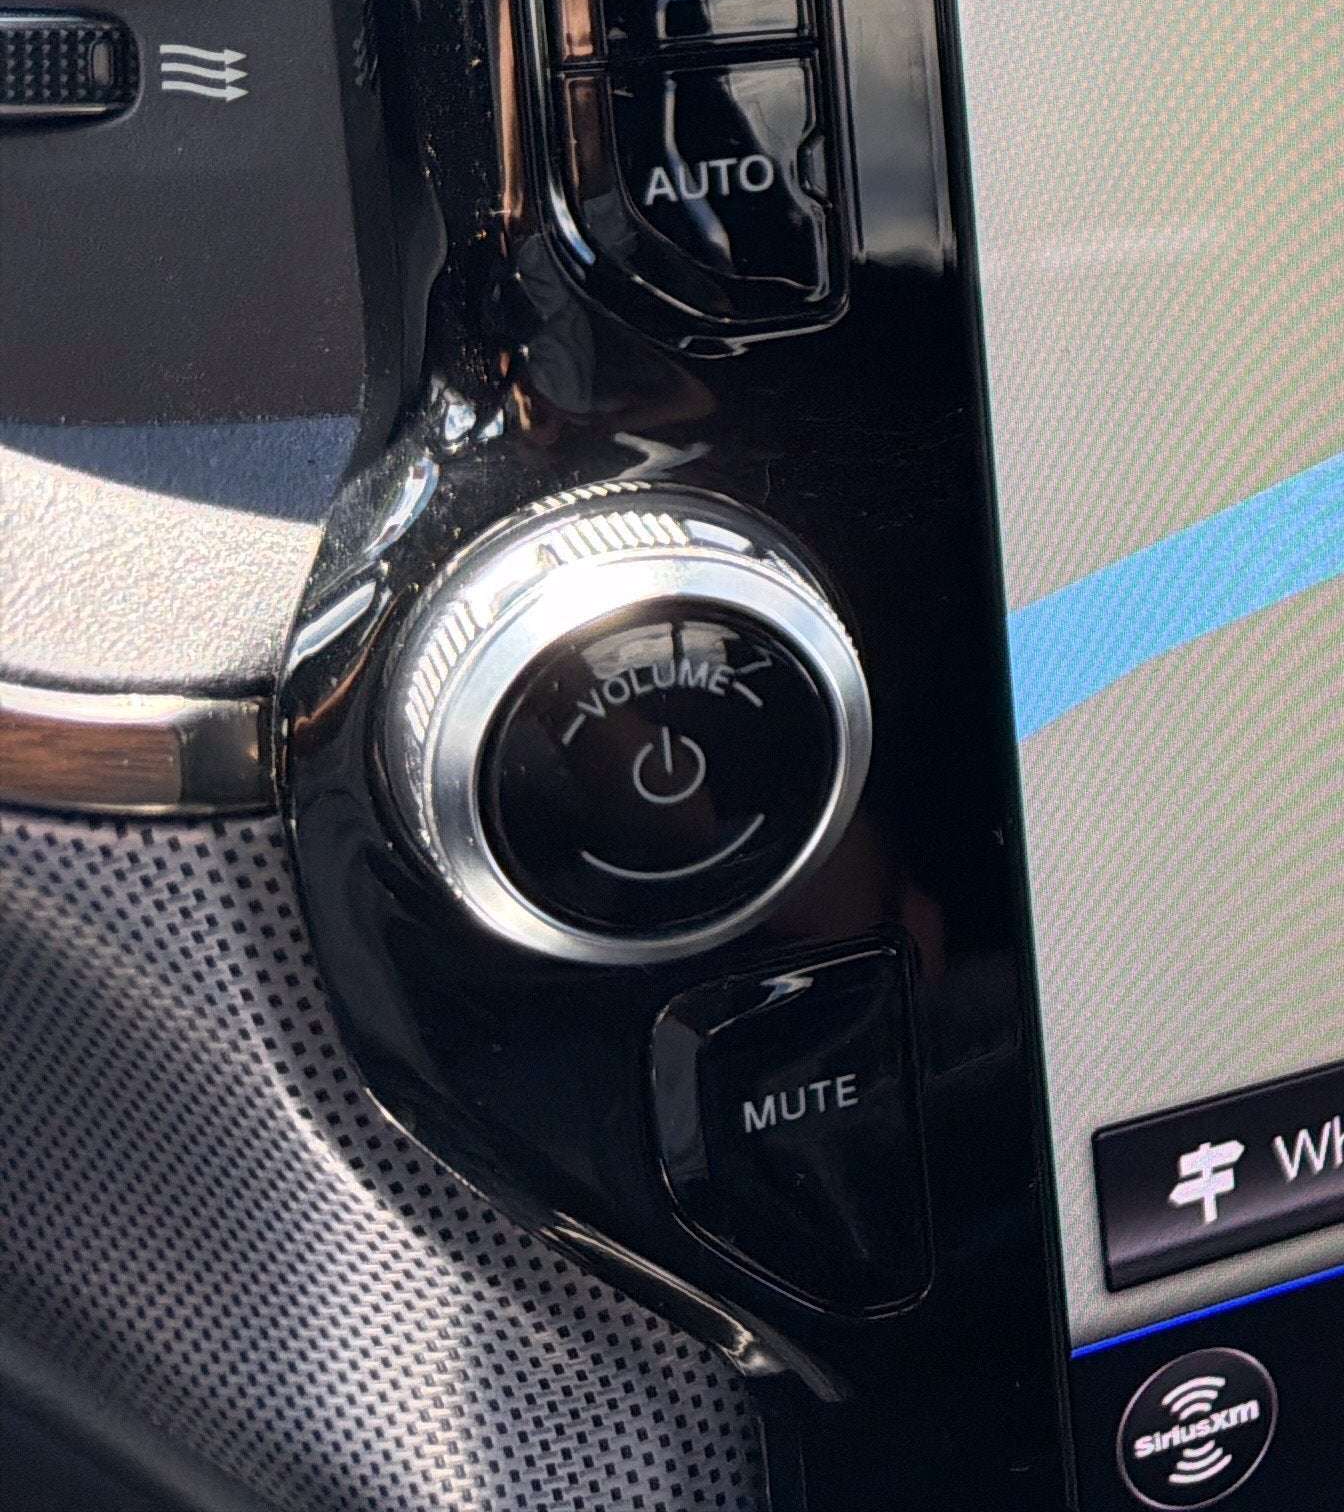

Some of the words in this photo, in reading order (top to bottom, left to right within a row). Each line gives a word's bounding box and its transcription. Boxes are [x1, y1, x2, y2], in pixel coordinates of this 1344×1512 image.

[644, 153, 777, 208] AUTO
[574, 658, 736, 721] VOLUME
[741, 1073, 860, 1134] MUTE
